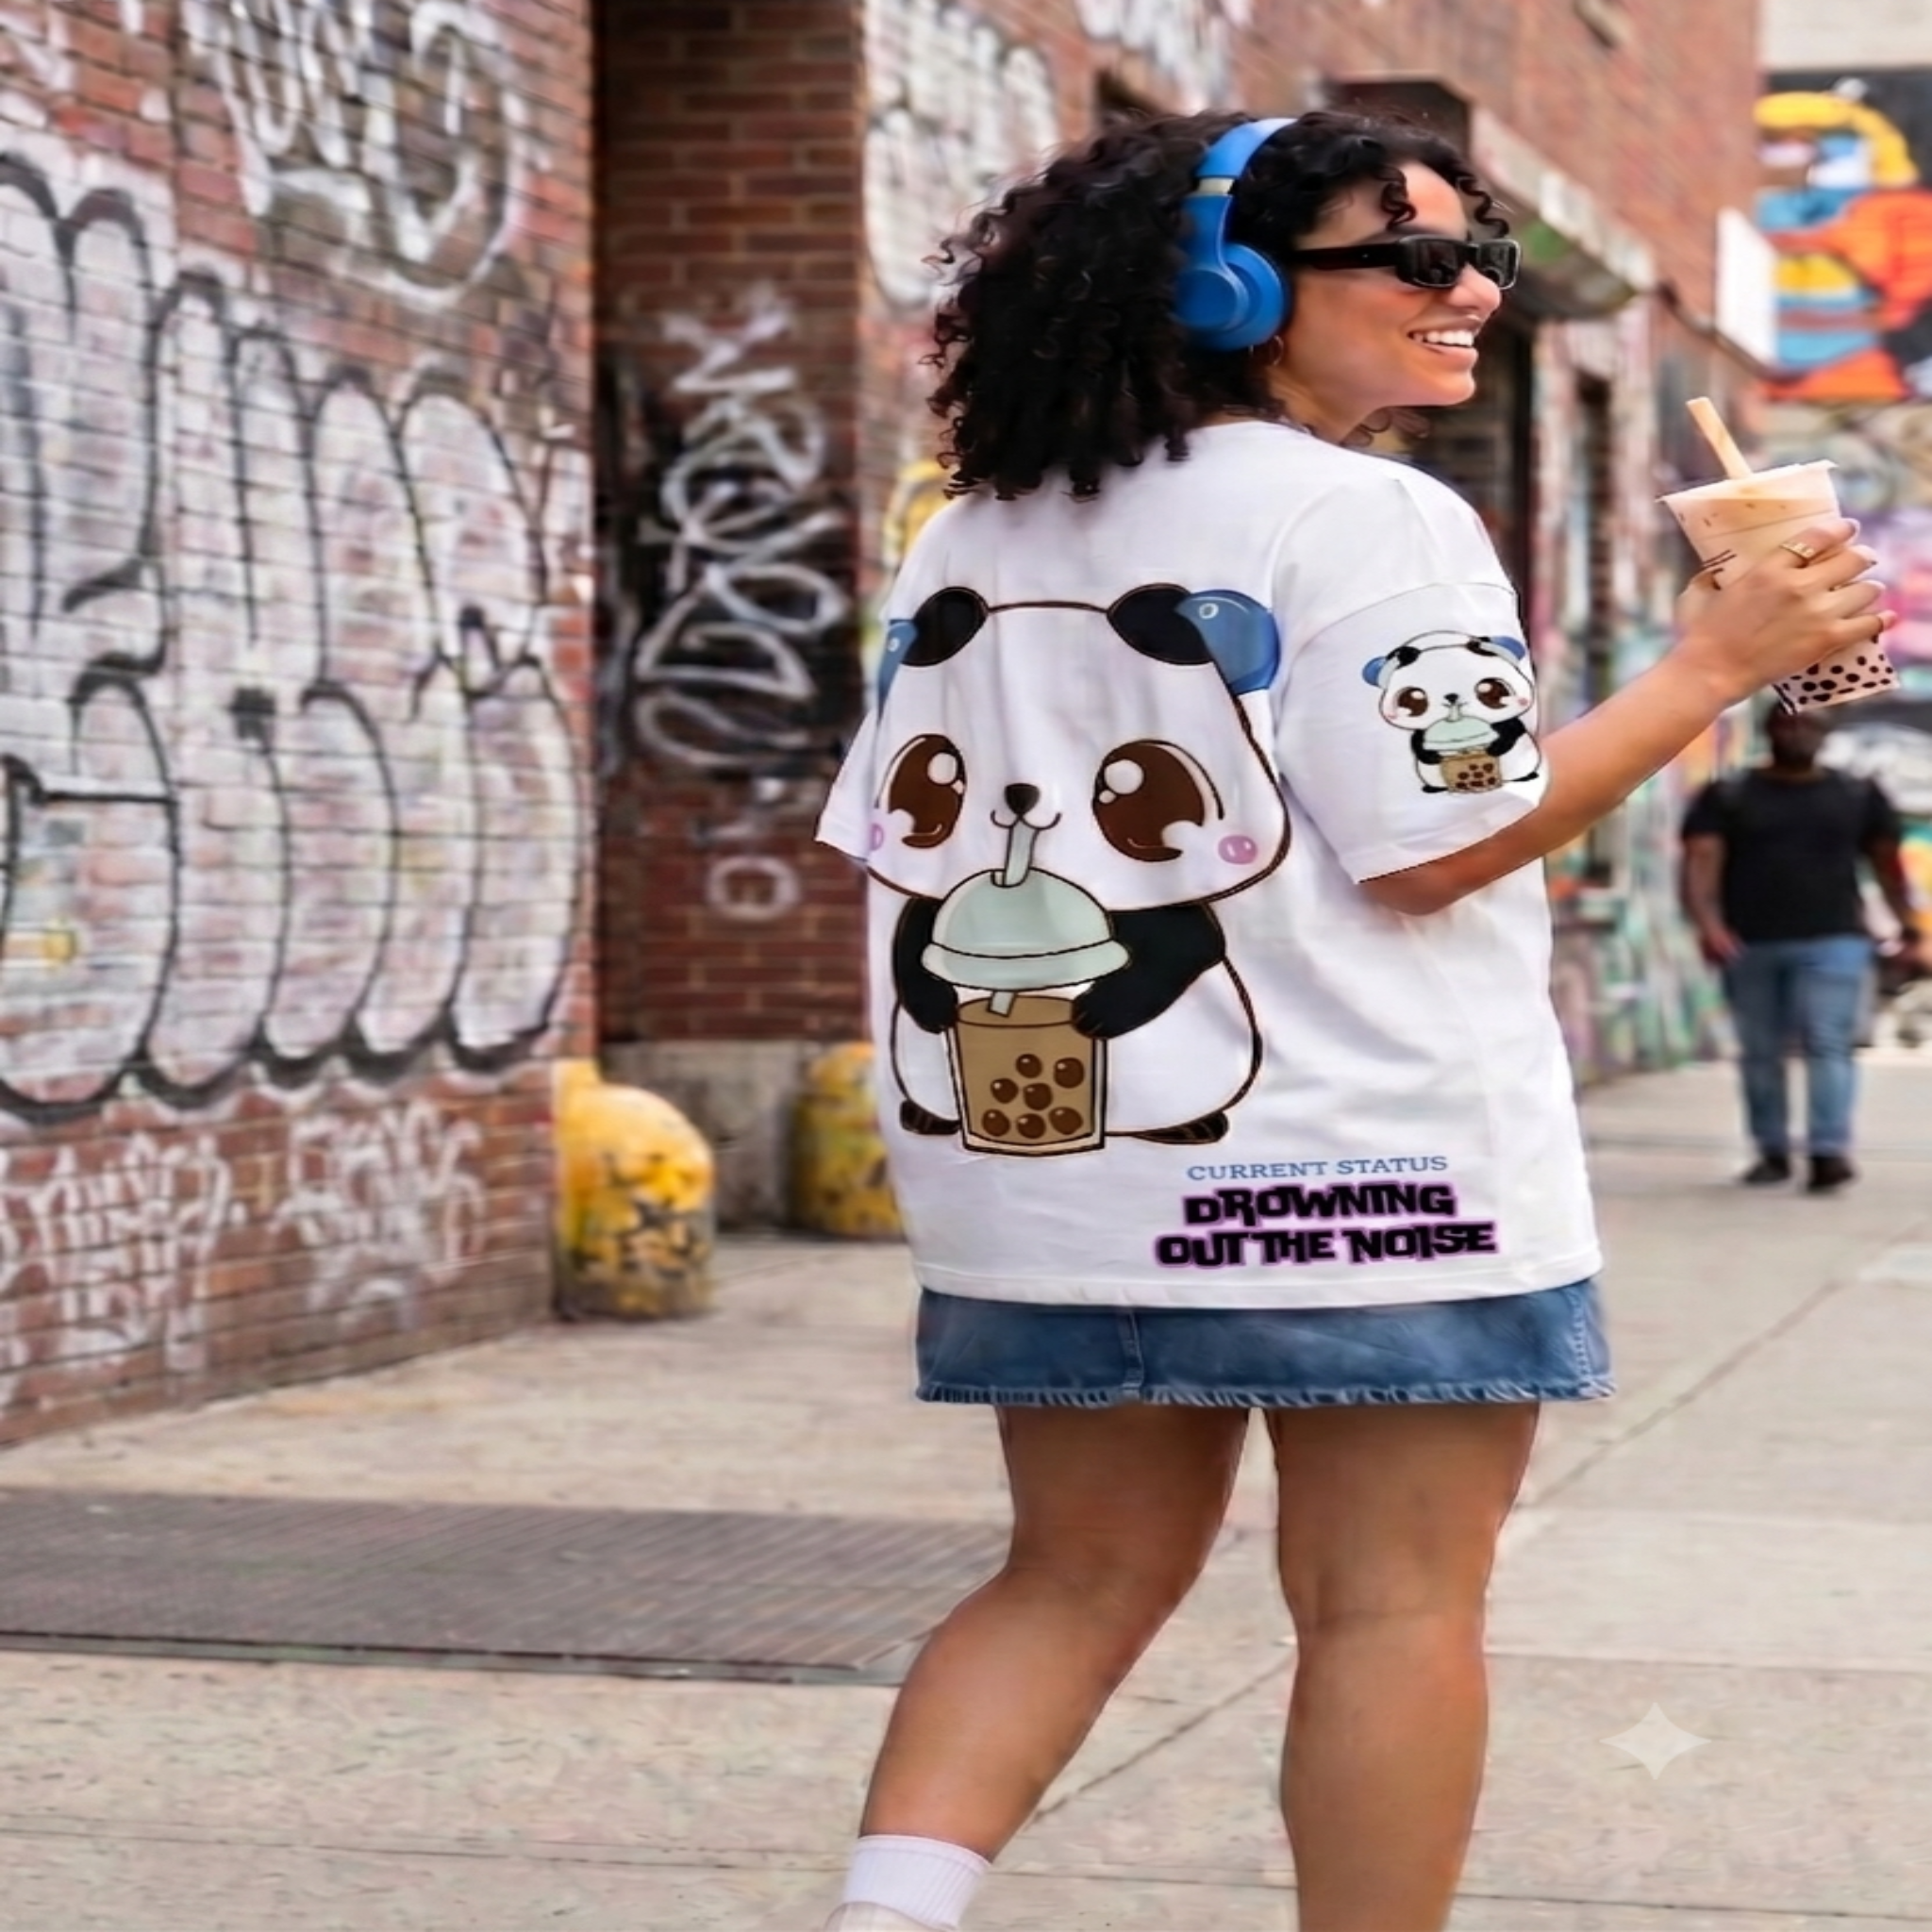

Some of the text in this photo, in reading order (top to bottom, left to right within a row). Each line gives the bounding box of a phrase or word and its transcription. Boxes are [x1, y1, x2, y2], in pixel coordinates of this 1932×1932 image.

[1187, 1156, 1448, 1181] CURRENT STATUS
[1183, 1181, 1457, 1226] DROWNING
[1156, 1221, 1499, 1269] OUT THE NOISE
